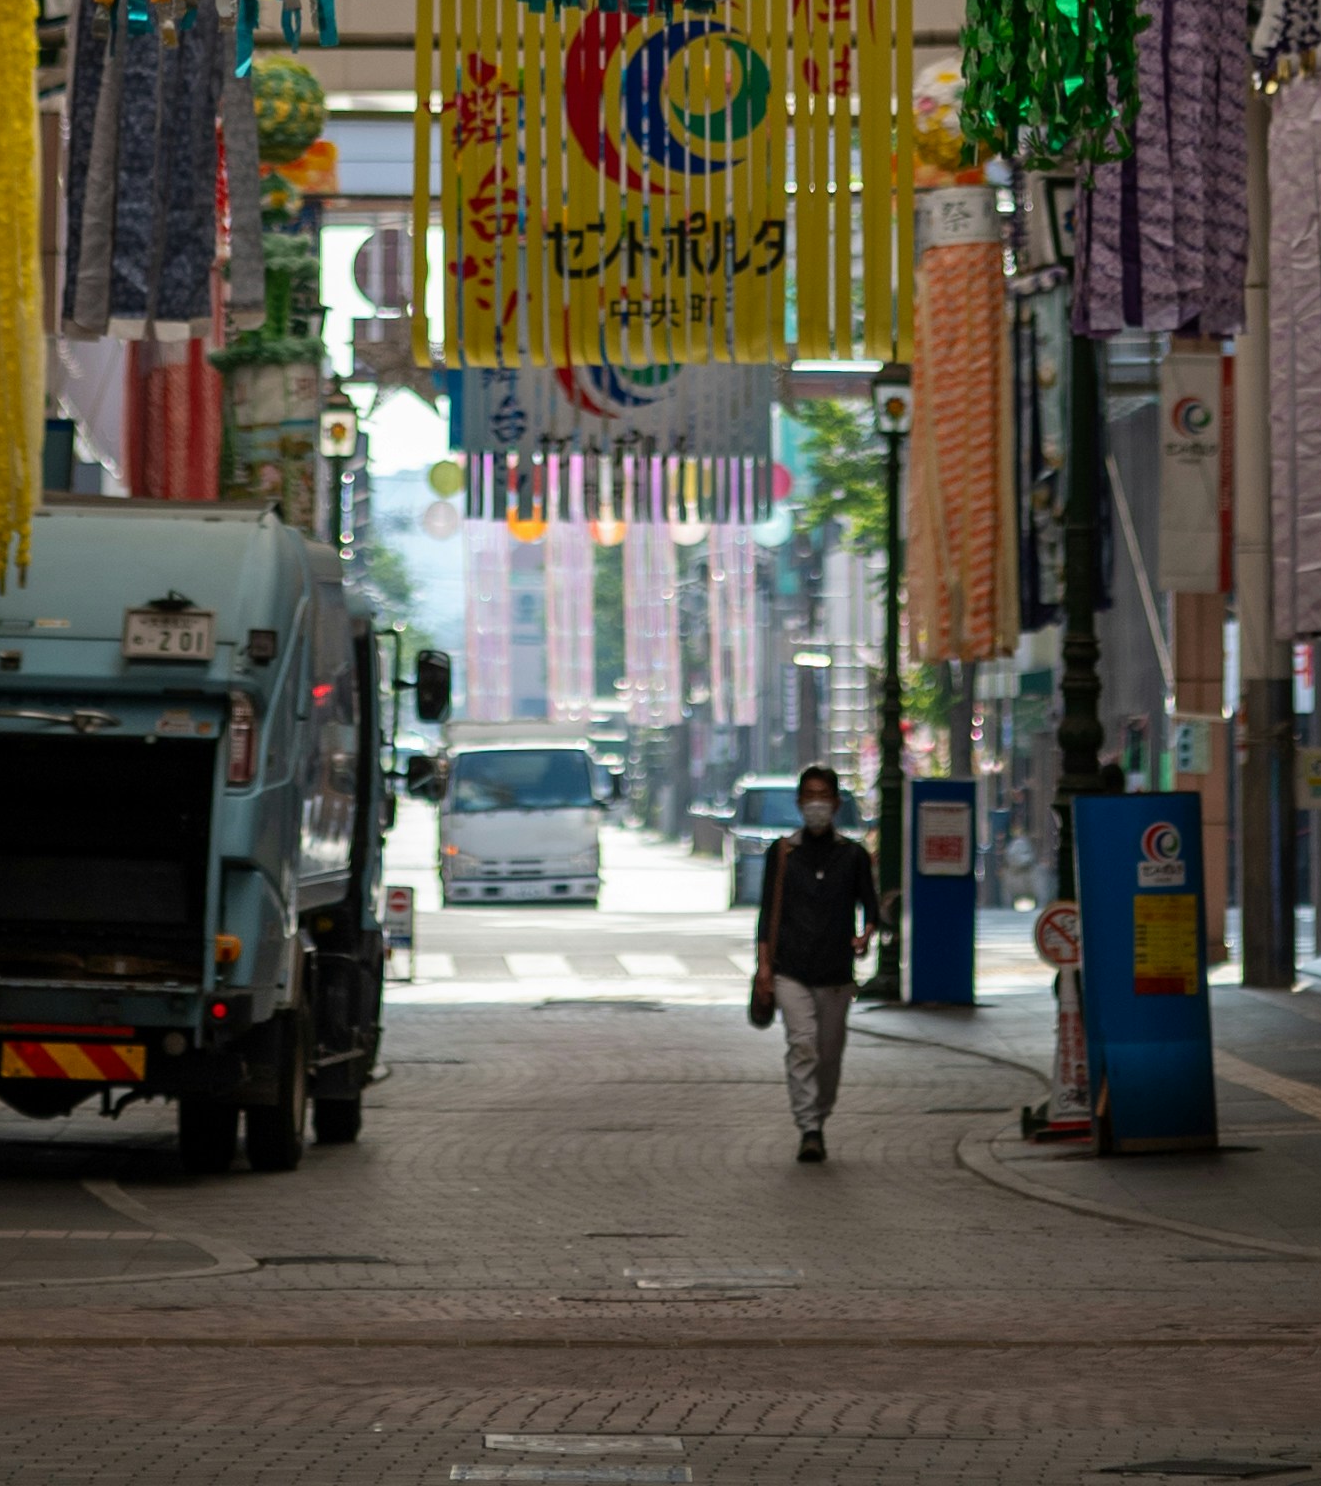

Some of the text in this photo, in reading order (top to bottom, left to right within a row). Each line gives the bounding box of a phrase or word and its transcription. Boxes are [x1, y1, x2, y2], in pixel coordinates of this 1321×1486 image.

[941, 201, 972, 232] 祭
[546, 210, 789, 280] セントポルタ
[609, 293, 719, 328] 中央町
